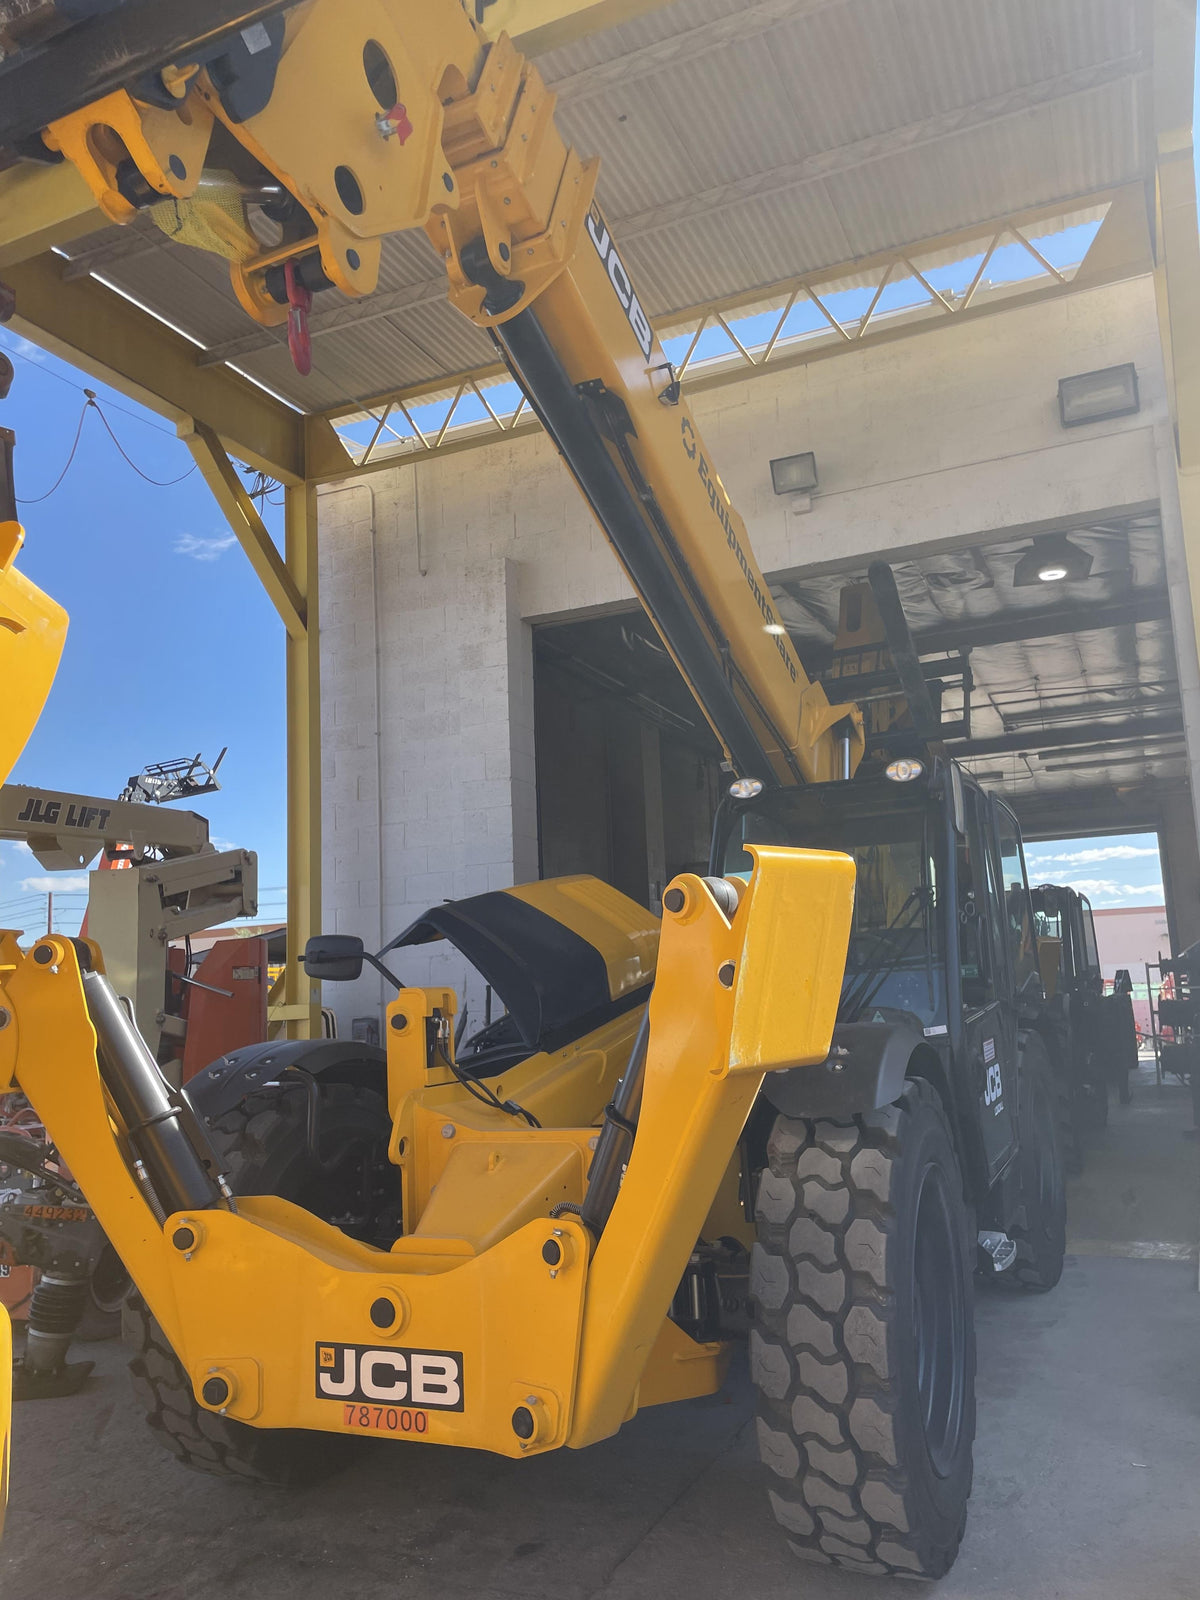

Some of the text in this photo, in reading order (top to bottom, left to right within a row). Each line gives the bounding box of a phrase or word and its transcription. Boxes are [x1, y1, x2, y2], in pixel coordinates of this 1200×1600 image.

[587, 214, 651, 355] JCB
[18, 798, 111, 830] JLG LIFT
[984, 1063, 1002, 1106] JCB
[319, 1348, 460, 1406] JCB
[345, 1404, 427, 1433] 787000
